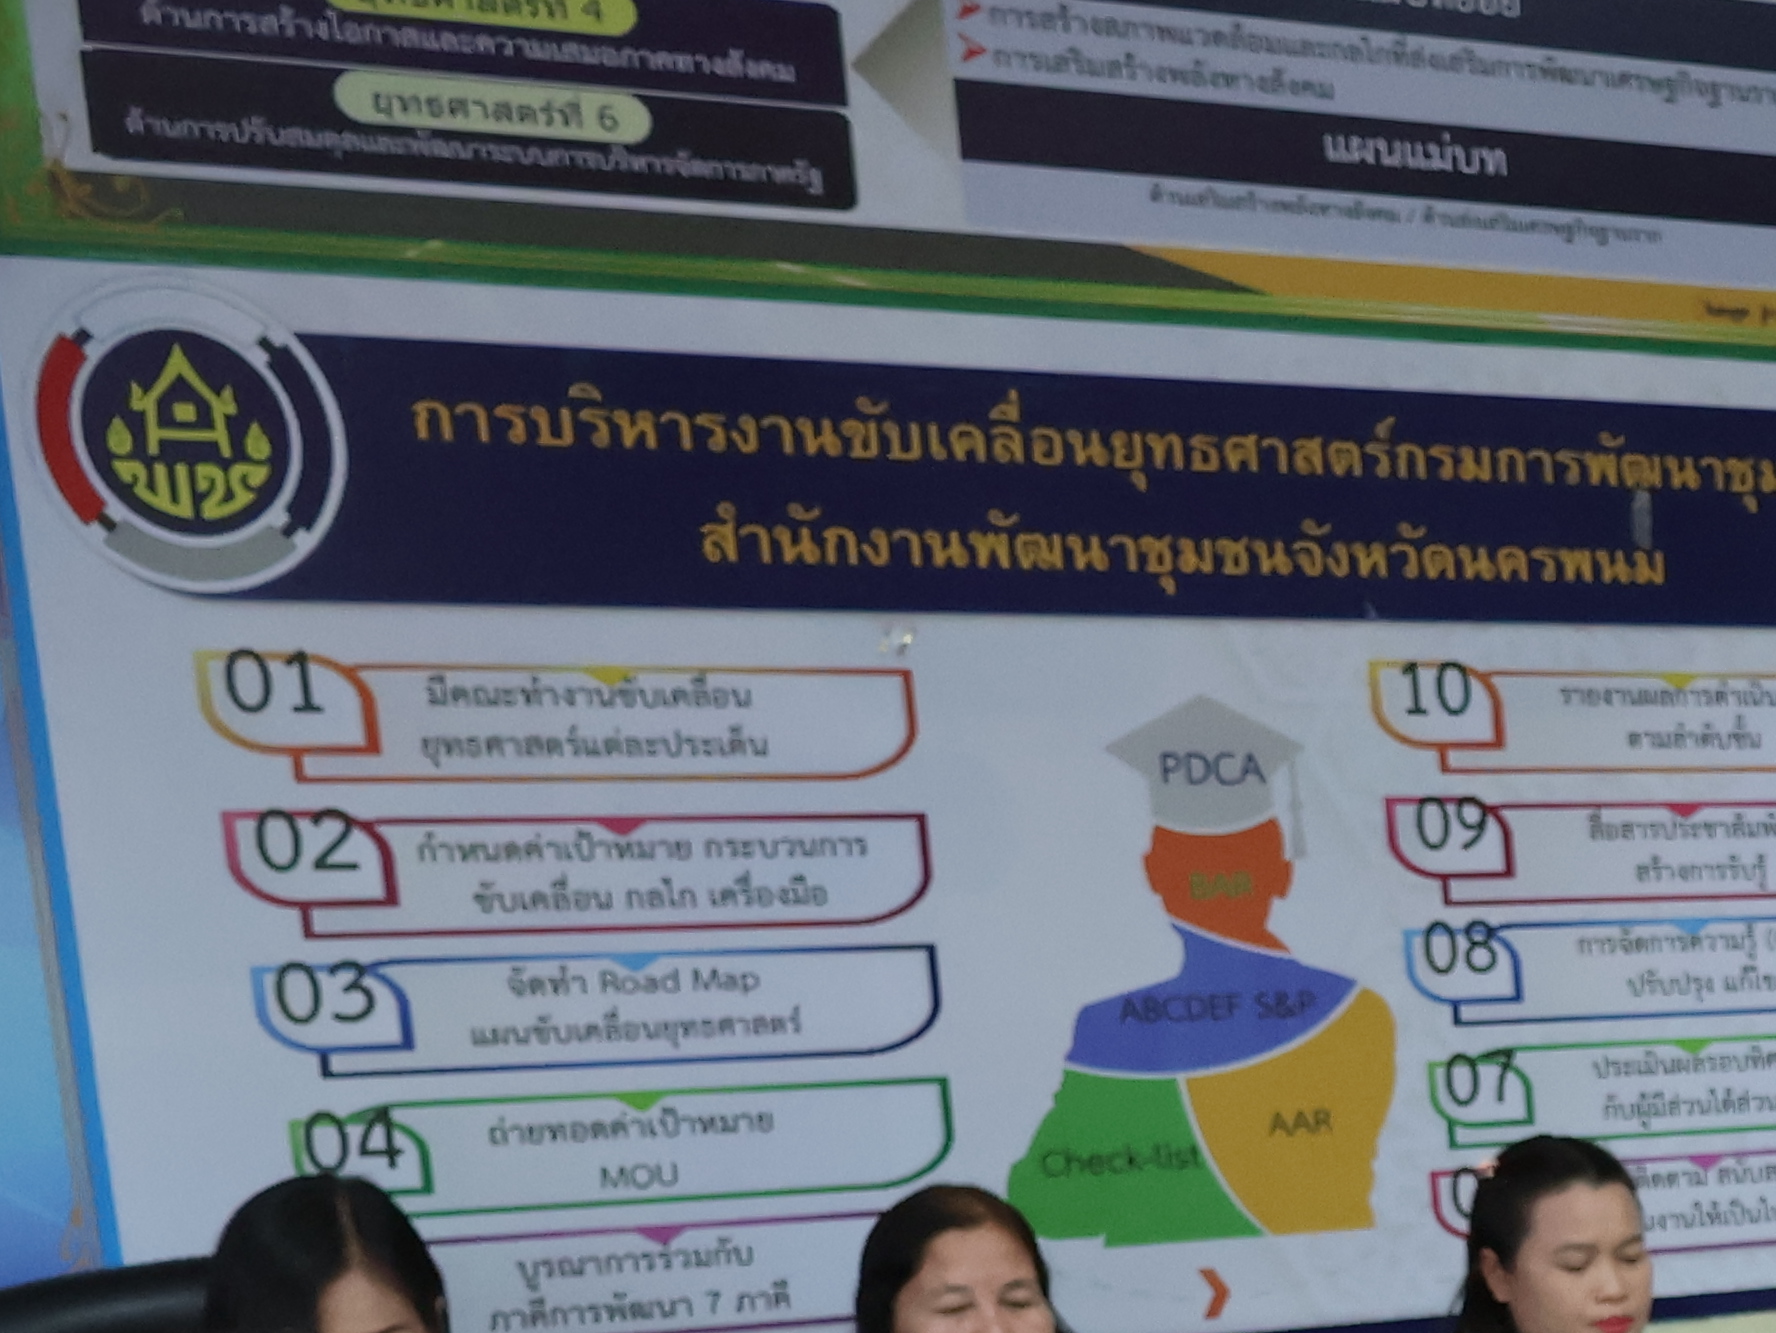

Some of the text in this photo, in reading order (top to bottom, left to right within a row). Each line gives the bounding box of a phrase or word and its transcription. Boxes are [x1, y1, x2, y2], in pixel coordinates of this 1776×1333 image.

[597, 103, 621, 132] 6
[1322, 131, 1509, 178] แผนแม่บท
[700, 502, 1666, 595] สำนักงานพัฒนาชุมชนจังหวัดนครพนม
[223, 648, 325, 714] 01
[1402, 660, 1473, 716] 10
[1160, 750, 1267, 786] PDCA
[254, 807, 362, 875] 02
[1414, 796, 1489, 851] 09
[1424, 920, 1498, 975] 08
[273, 959, 378, 1025] 03
[600, 968, 682, 995] Road
[691, 968, 760, 999] Map
[1445, 1049, 1517, 1107] 07
[303, 1106, 404, 1173] 04
[1269, 1108, 1333, 1136] AAR
[600, 1161, 679, 1192] MOU
[706, 1290, 723, 1316] 7
